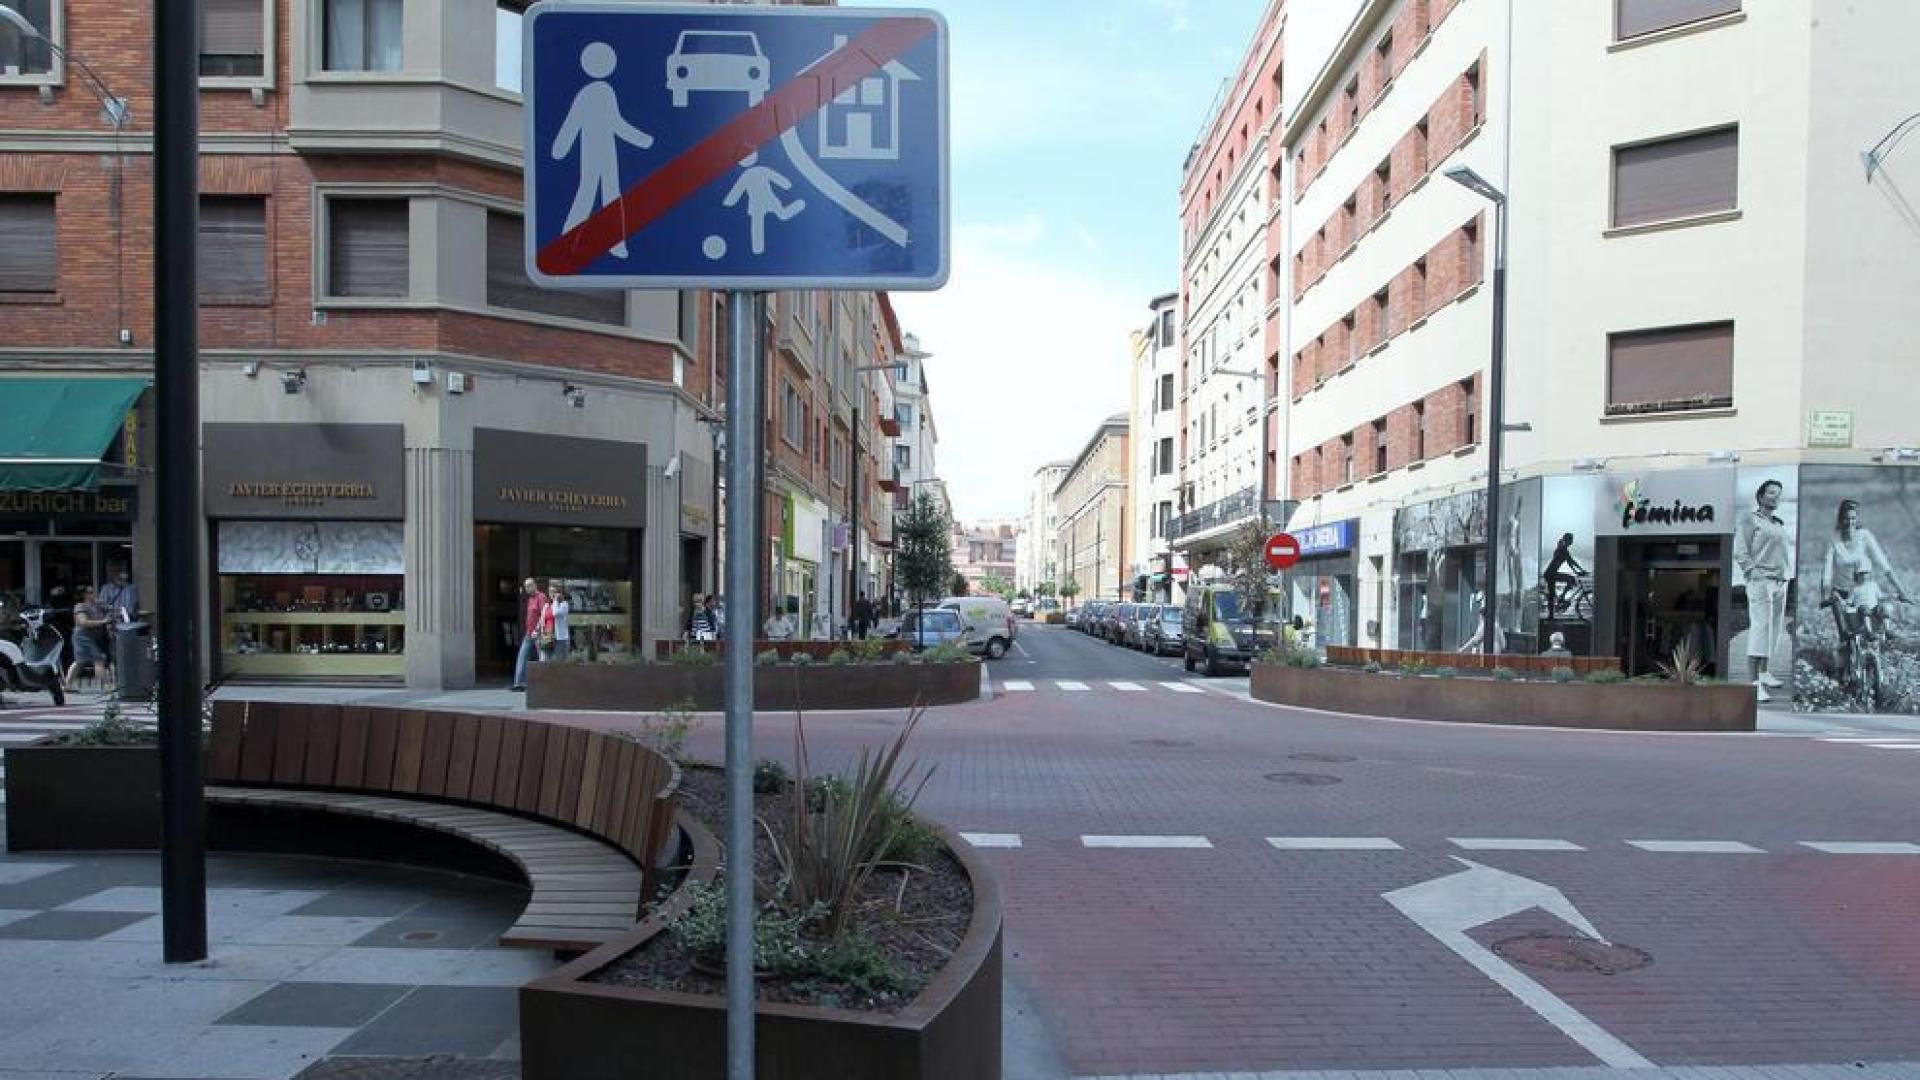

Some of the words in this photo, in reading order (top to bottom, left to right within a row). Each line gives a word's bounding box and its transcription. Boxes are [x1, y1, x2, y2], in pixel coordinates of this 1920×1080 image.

[227, 482, 282, 497] JAVIER
[283, 482, 375, 497] ECHEVERRIA
[498, 486, 546, 502] JAVIER
[547, 490, 626, 507] ECHEVERRIA
[95, 495, 128, 512] bar
